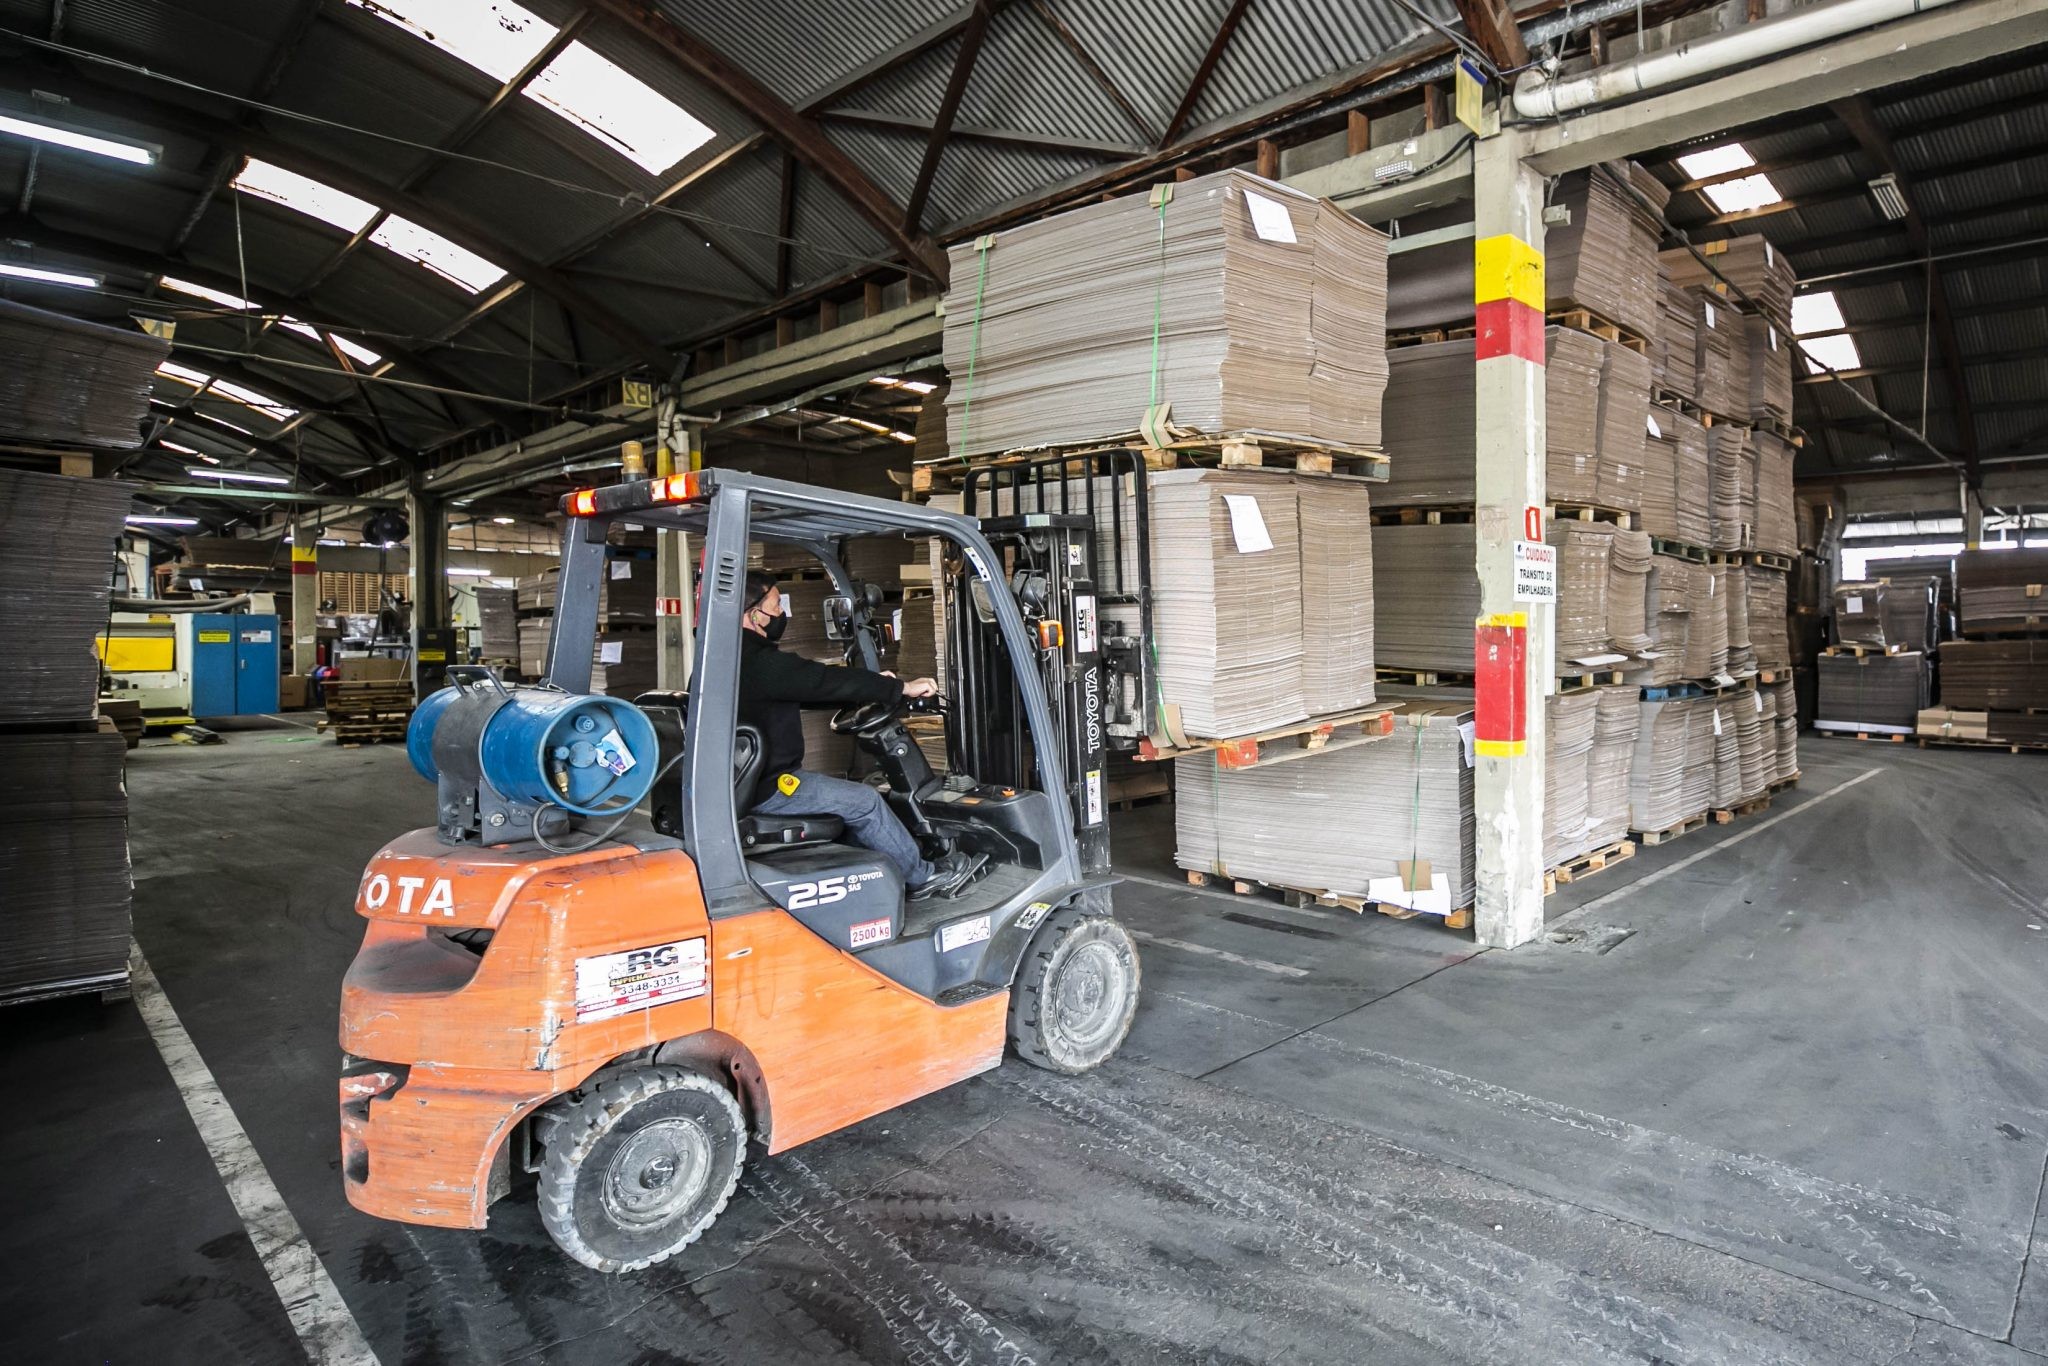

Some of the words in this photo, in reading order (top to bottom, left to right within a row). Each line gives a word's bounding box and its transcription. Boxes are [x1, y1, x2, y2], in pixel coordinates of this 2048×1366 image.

[1546, 571, 1553, 582] DE
[1085, 667, 1100, 754] TOYOTA
[788, 877, 847, 910] 25
[858, 871, 884, 882] TOYOTA
[848, 883, 862, 892] SAS
[853, 929, 877, 942] 2500
[879, 925, 890, 938] kg
[628, 946, 679, 973] RG
